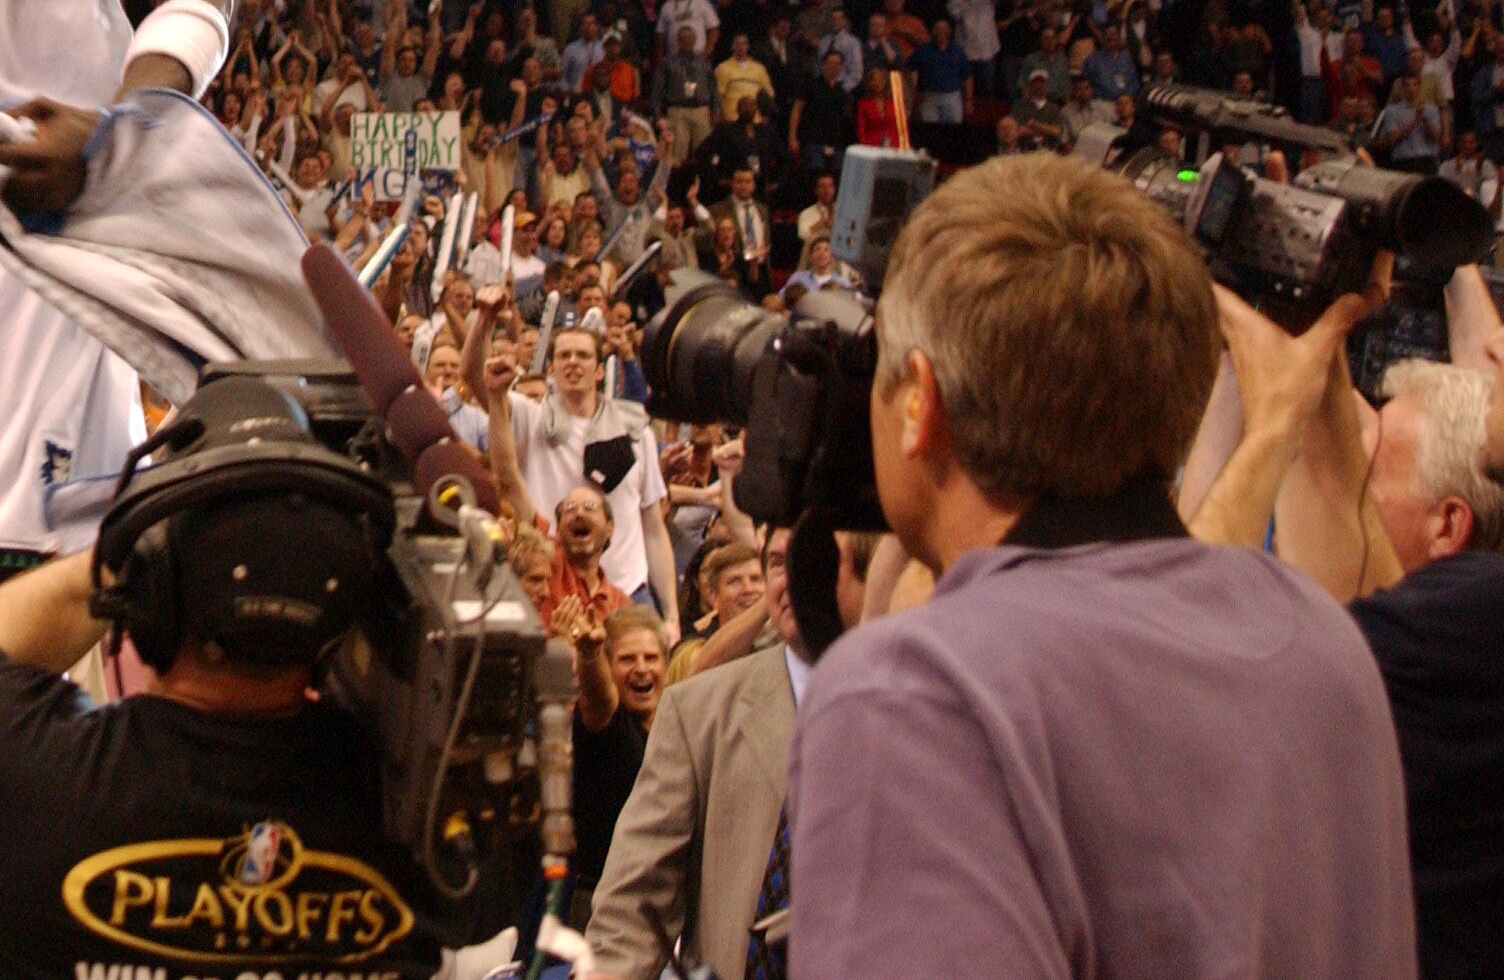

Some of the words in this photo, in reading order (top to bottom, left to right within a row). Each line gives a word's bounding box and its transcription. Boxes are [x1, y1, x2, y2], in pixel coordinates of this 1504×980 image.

[352, 111, 445, 140] HAPPY
[351, 137, 457, 168] BIRTDAY
[109, 870, 387, 944] PLAYOFFS
